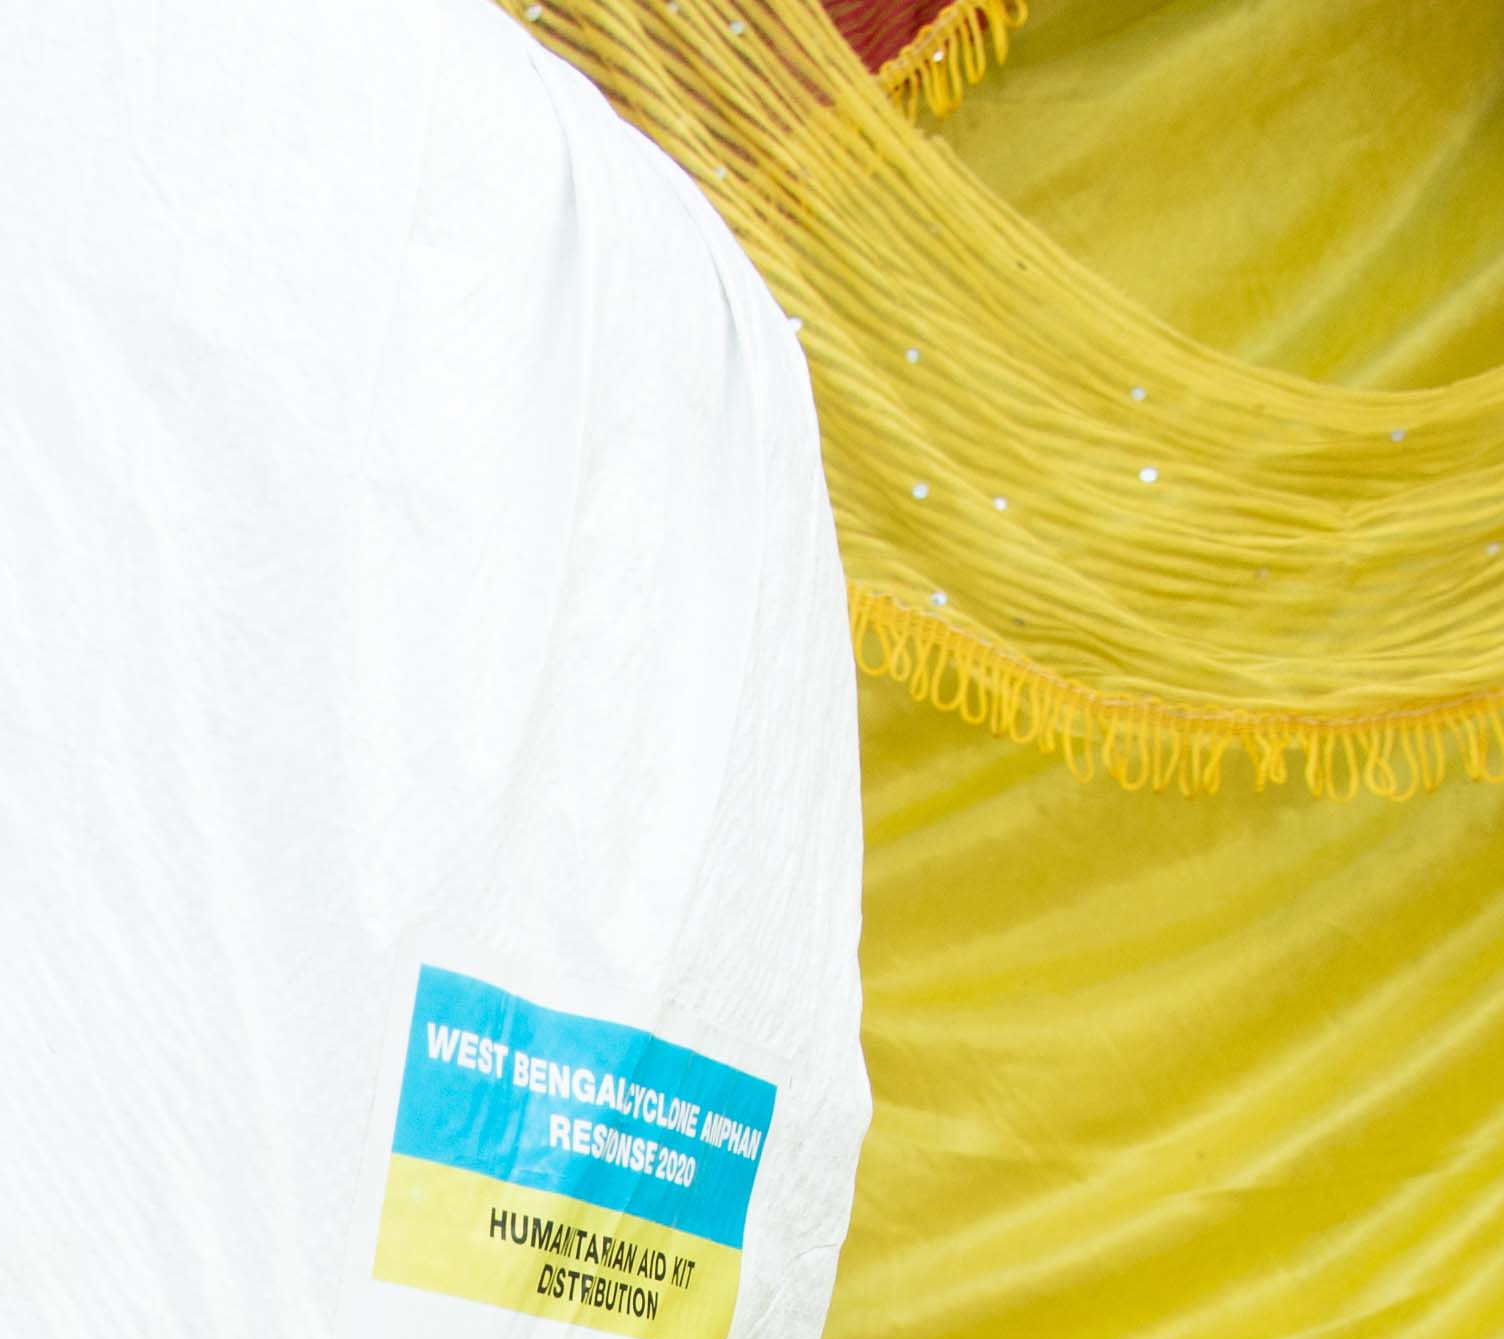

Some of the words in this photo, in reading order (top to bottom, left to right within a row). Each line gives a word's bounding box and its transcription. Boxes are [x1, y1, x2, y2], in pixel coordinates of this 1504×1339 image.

[427, 1022, 509, 1079] WEST
[513, 1051, 629, 1114] BENGAL
[623, 1081, 701, 1138] CYCLONE
[700, 1111, 762, 1160] AMPHAN
[655, 1147, 696, 1187] 2020
[537, 1263, 659, 1320] DISTRIBUTION
[637, 1248, 667, 1281] AID
[671, 1255, 696, 1289] KIT
